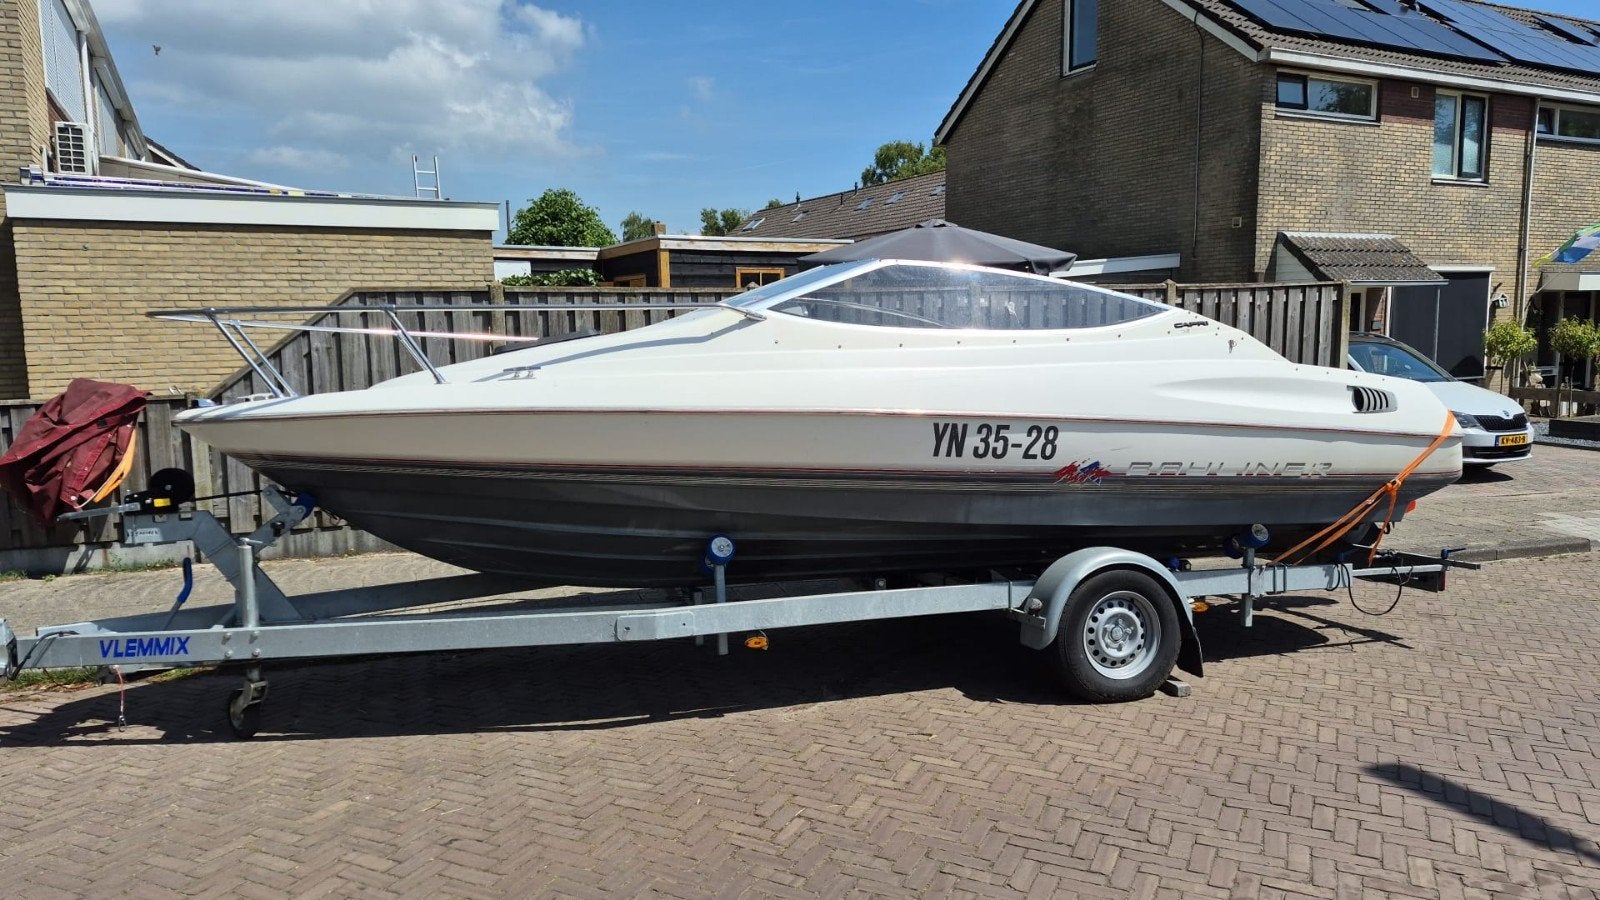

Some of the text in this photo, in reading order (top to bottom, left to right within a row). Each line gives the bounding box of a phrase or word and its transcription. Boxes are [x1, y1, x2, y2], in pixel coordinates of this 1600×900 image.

[932, 422, 1059, 460] YN 35-28
[1126, 461, 1333, 478] BAYLINER
[99, 636, 190, 658] VLEMMIX
